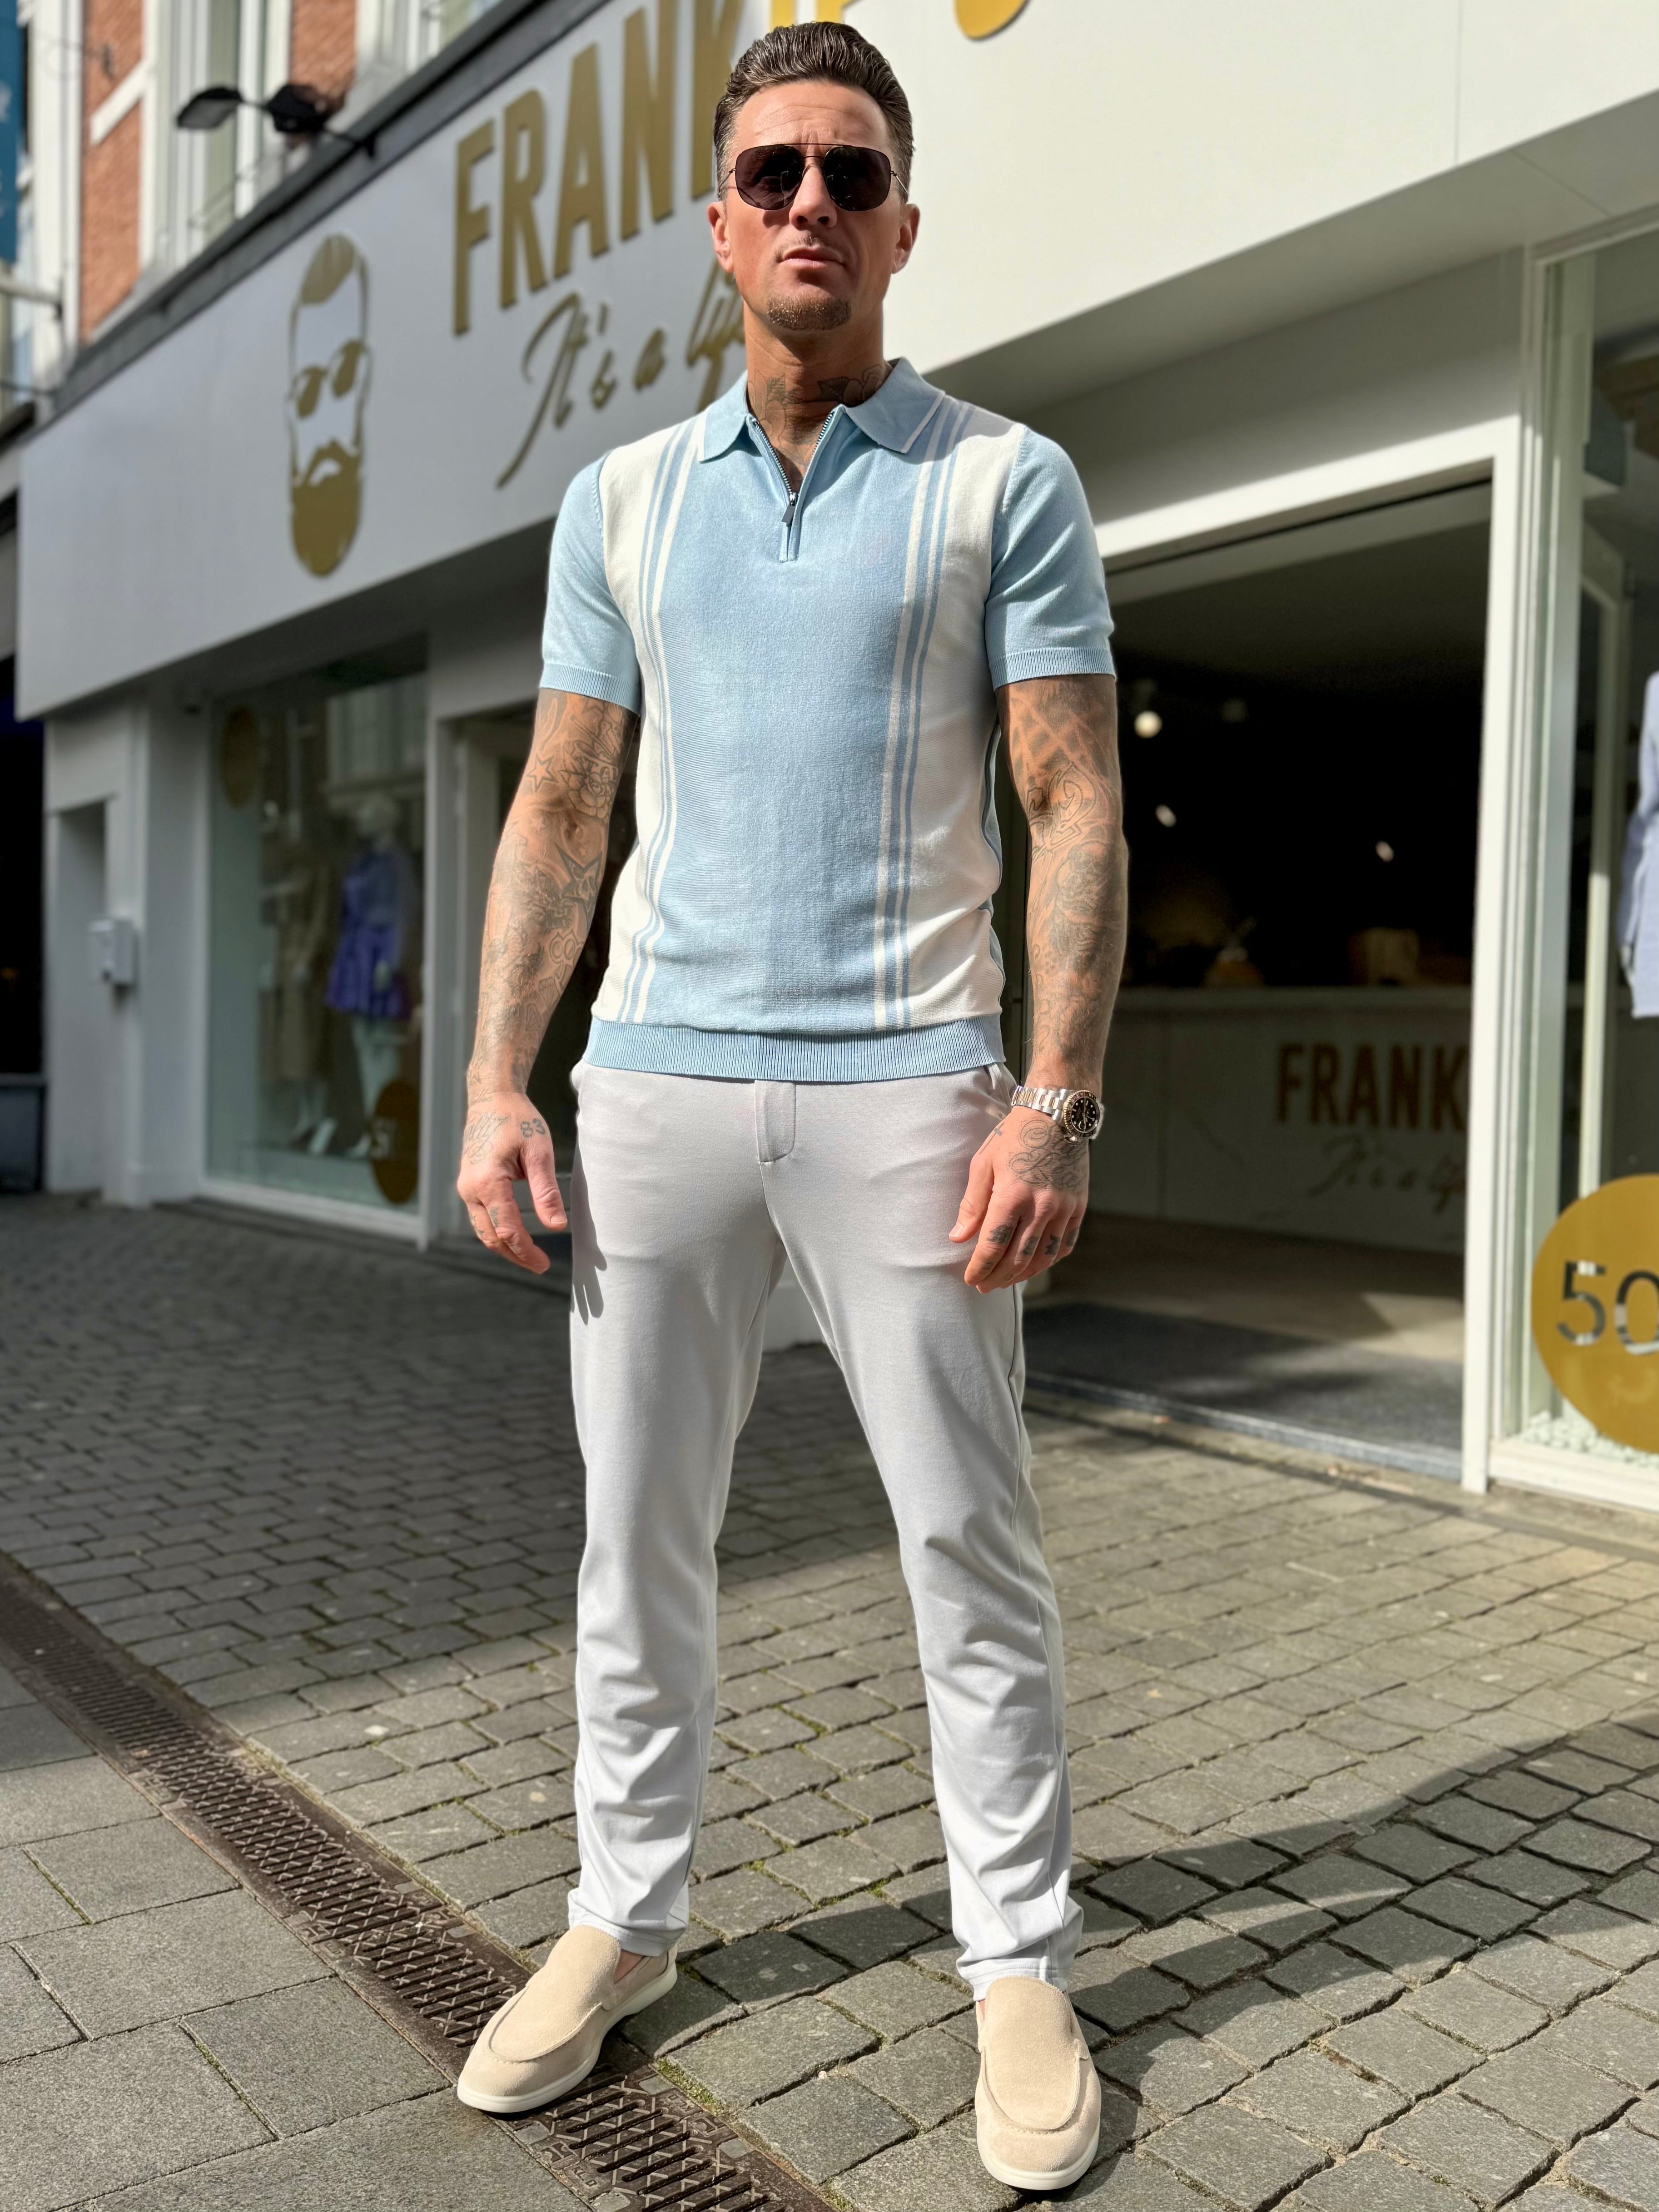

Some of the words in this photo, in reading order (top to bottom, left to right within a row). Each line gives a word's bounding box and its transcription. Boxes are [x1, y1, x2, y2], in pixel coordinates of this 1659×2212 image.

[452, 0, 859, 338] FRANK
[520, 1118, 546, 1138] 83
[1278, 1040, 1467, 1132] FRANK
